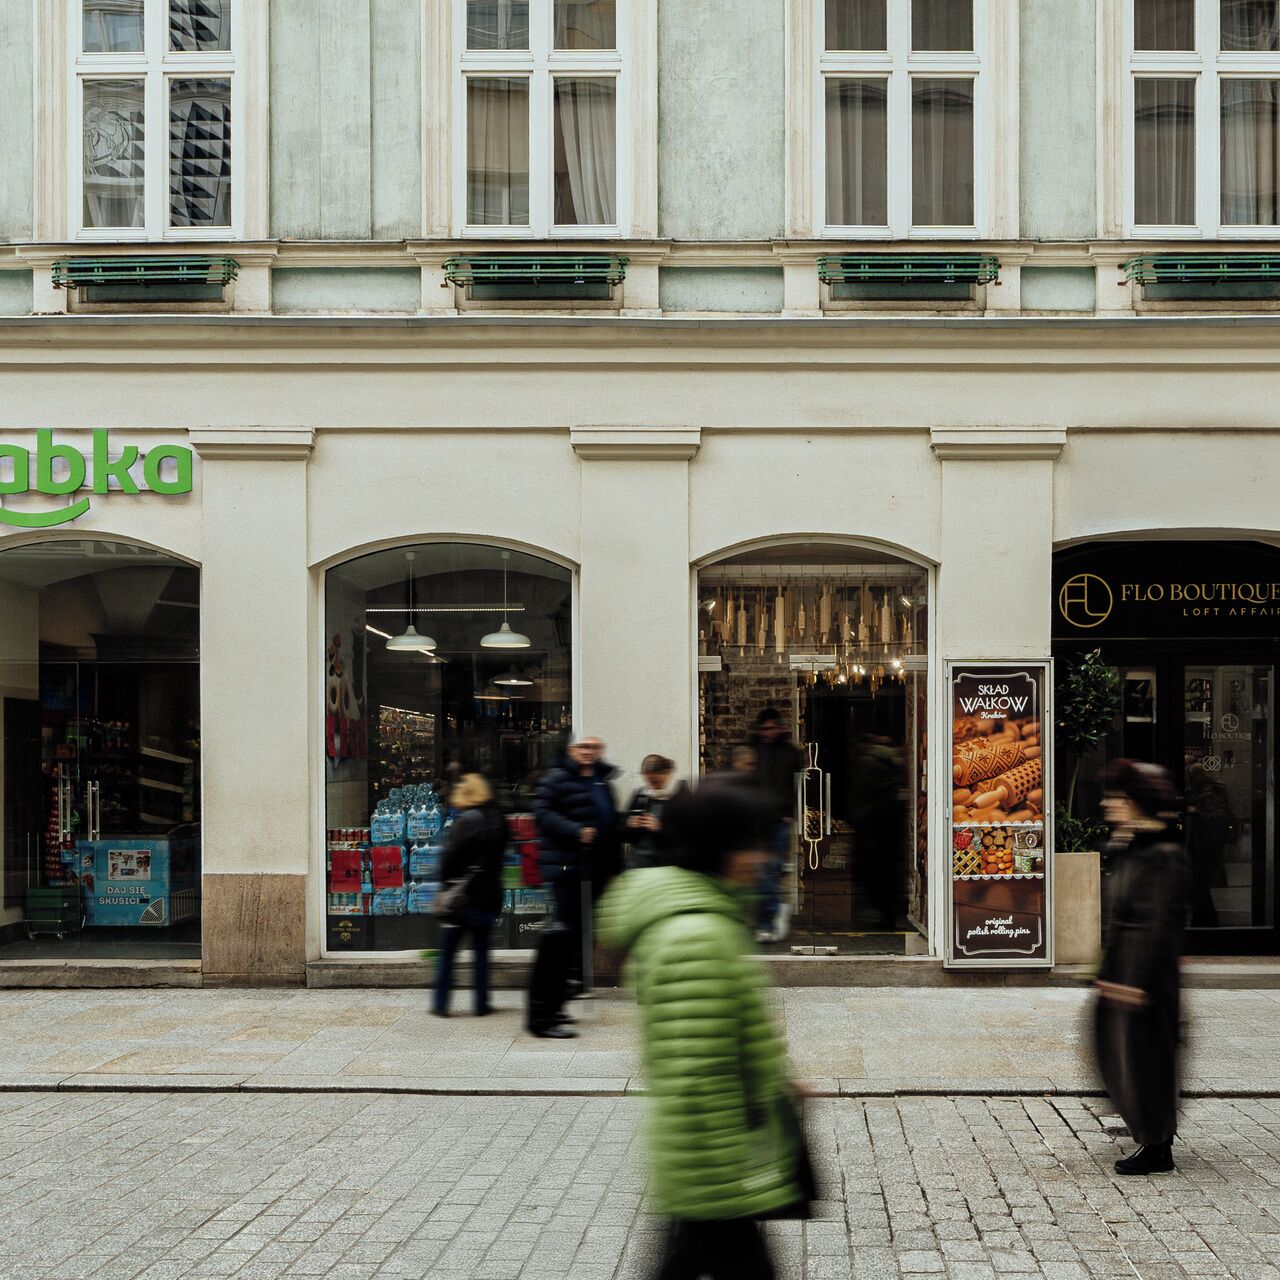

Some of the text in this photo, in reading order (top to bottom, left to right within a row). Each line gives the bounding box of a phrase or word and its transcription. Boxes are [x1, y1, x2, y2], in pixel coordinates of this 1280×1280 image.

[1121, 584, 1164, 601] FLO
[1183, 607, 1220, 616] LOFT
[977, 684, 1009, 695] SKŁAD
[107, 886, 126, 894] DAJ
[985, 916, 1013, 928] original
[966, 926, 1031, 939] polish rolling pins
